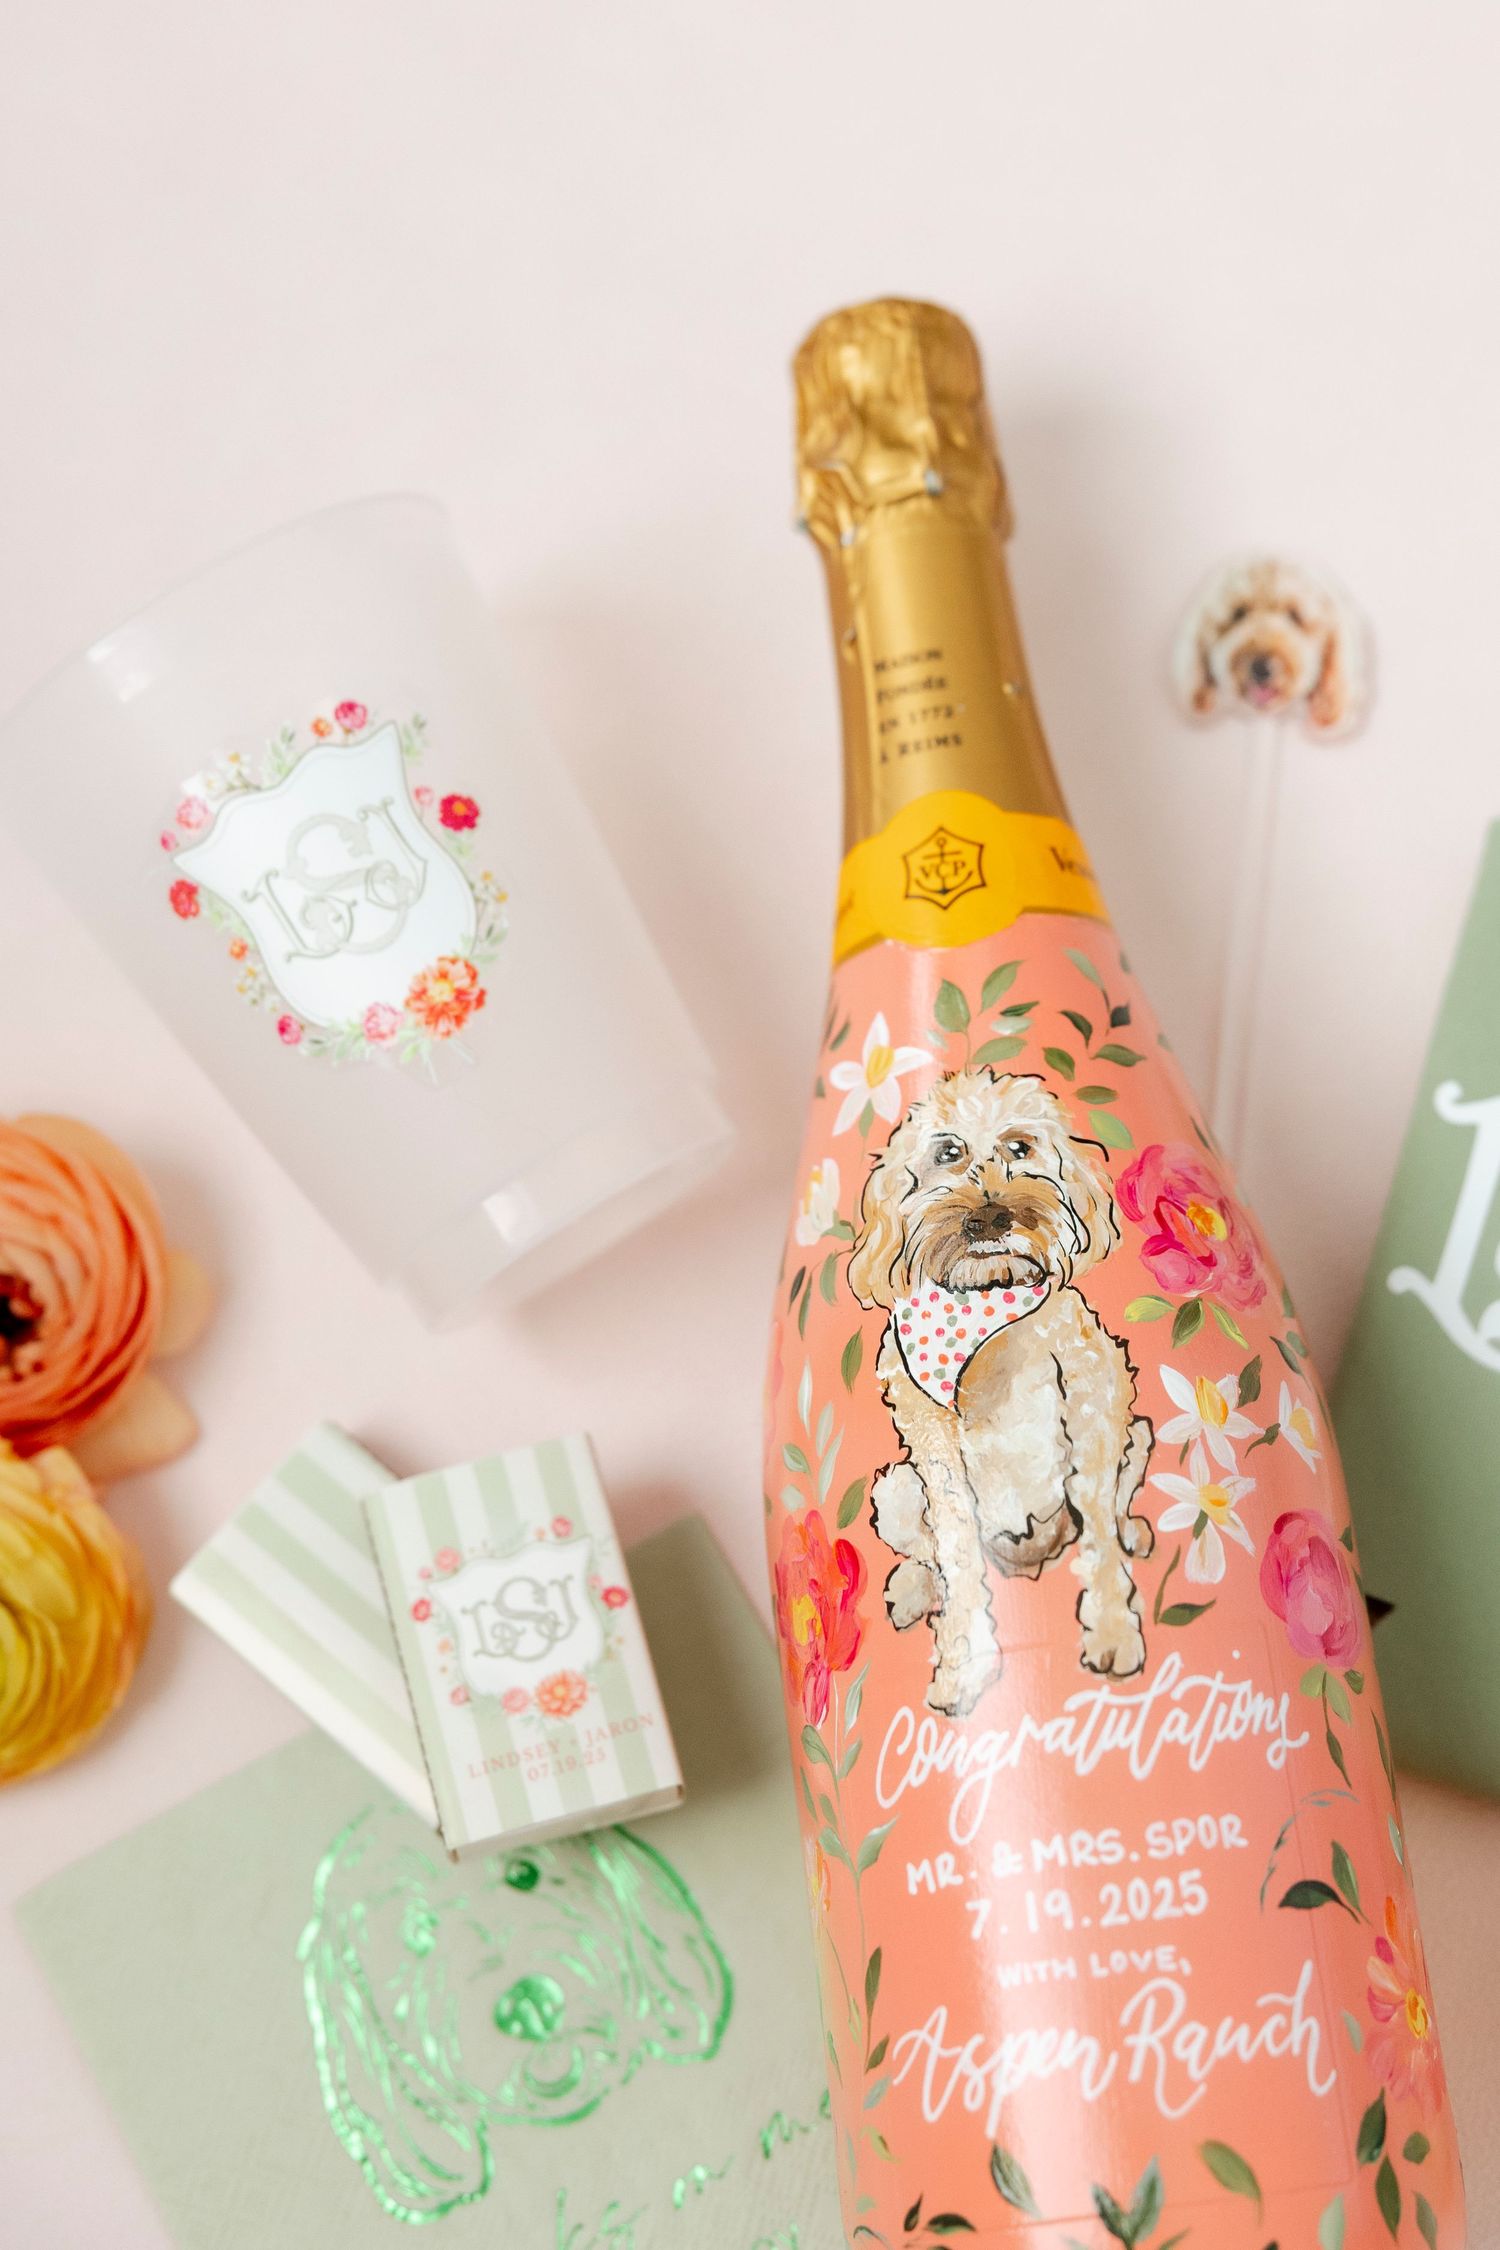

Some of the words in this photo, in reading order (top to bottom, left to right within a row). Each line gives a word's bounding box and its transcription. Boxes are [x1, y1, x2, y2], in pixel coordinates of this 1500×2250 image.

[467, 1738, 561, 1780] LINDSEY
[875, 1650, 1310, 1847] Congratulations
[906, 1851, 979, 1896] MR.
[1030, 1827, 1141, 1873] MRS.
[1145, 1813, 1250, 1859] SPOR
[995, 1957, 1078, 1989] WITH
[1089, 1944, 1193, 1977] LOVE,
[892, 2004, 1119, 2140] Aspen
[1119, 1959, 1338, 2119] Ranch
